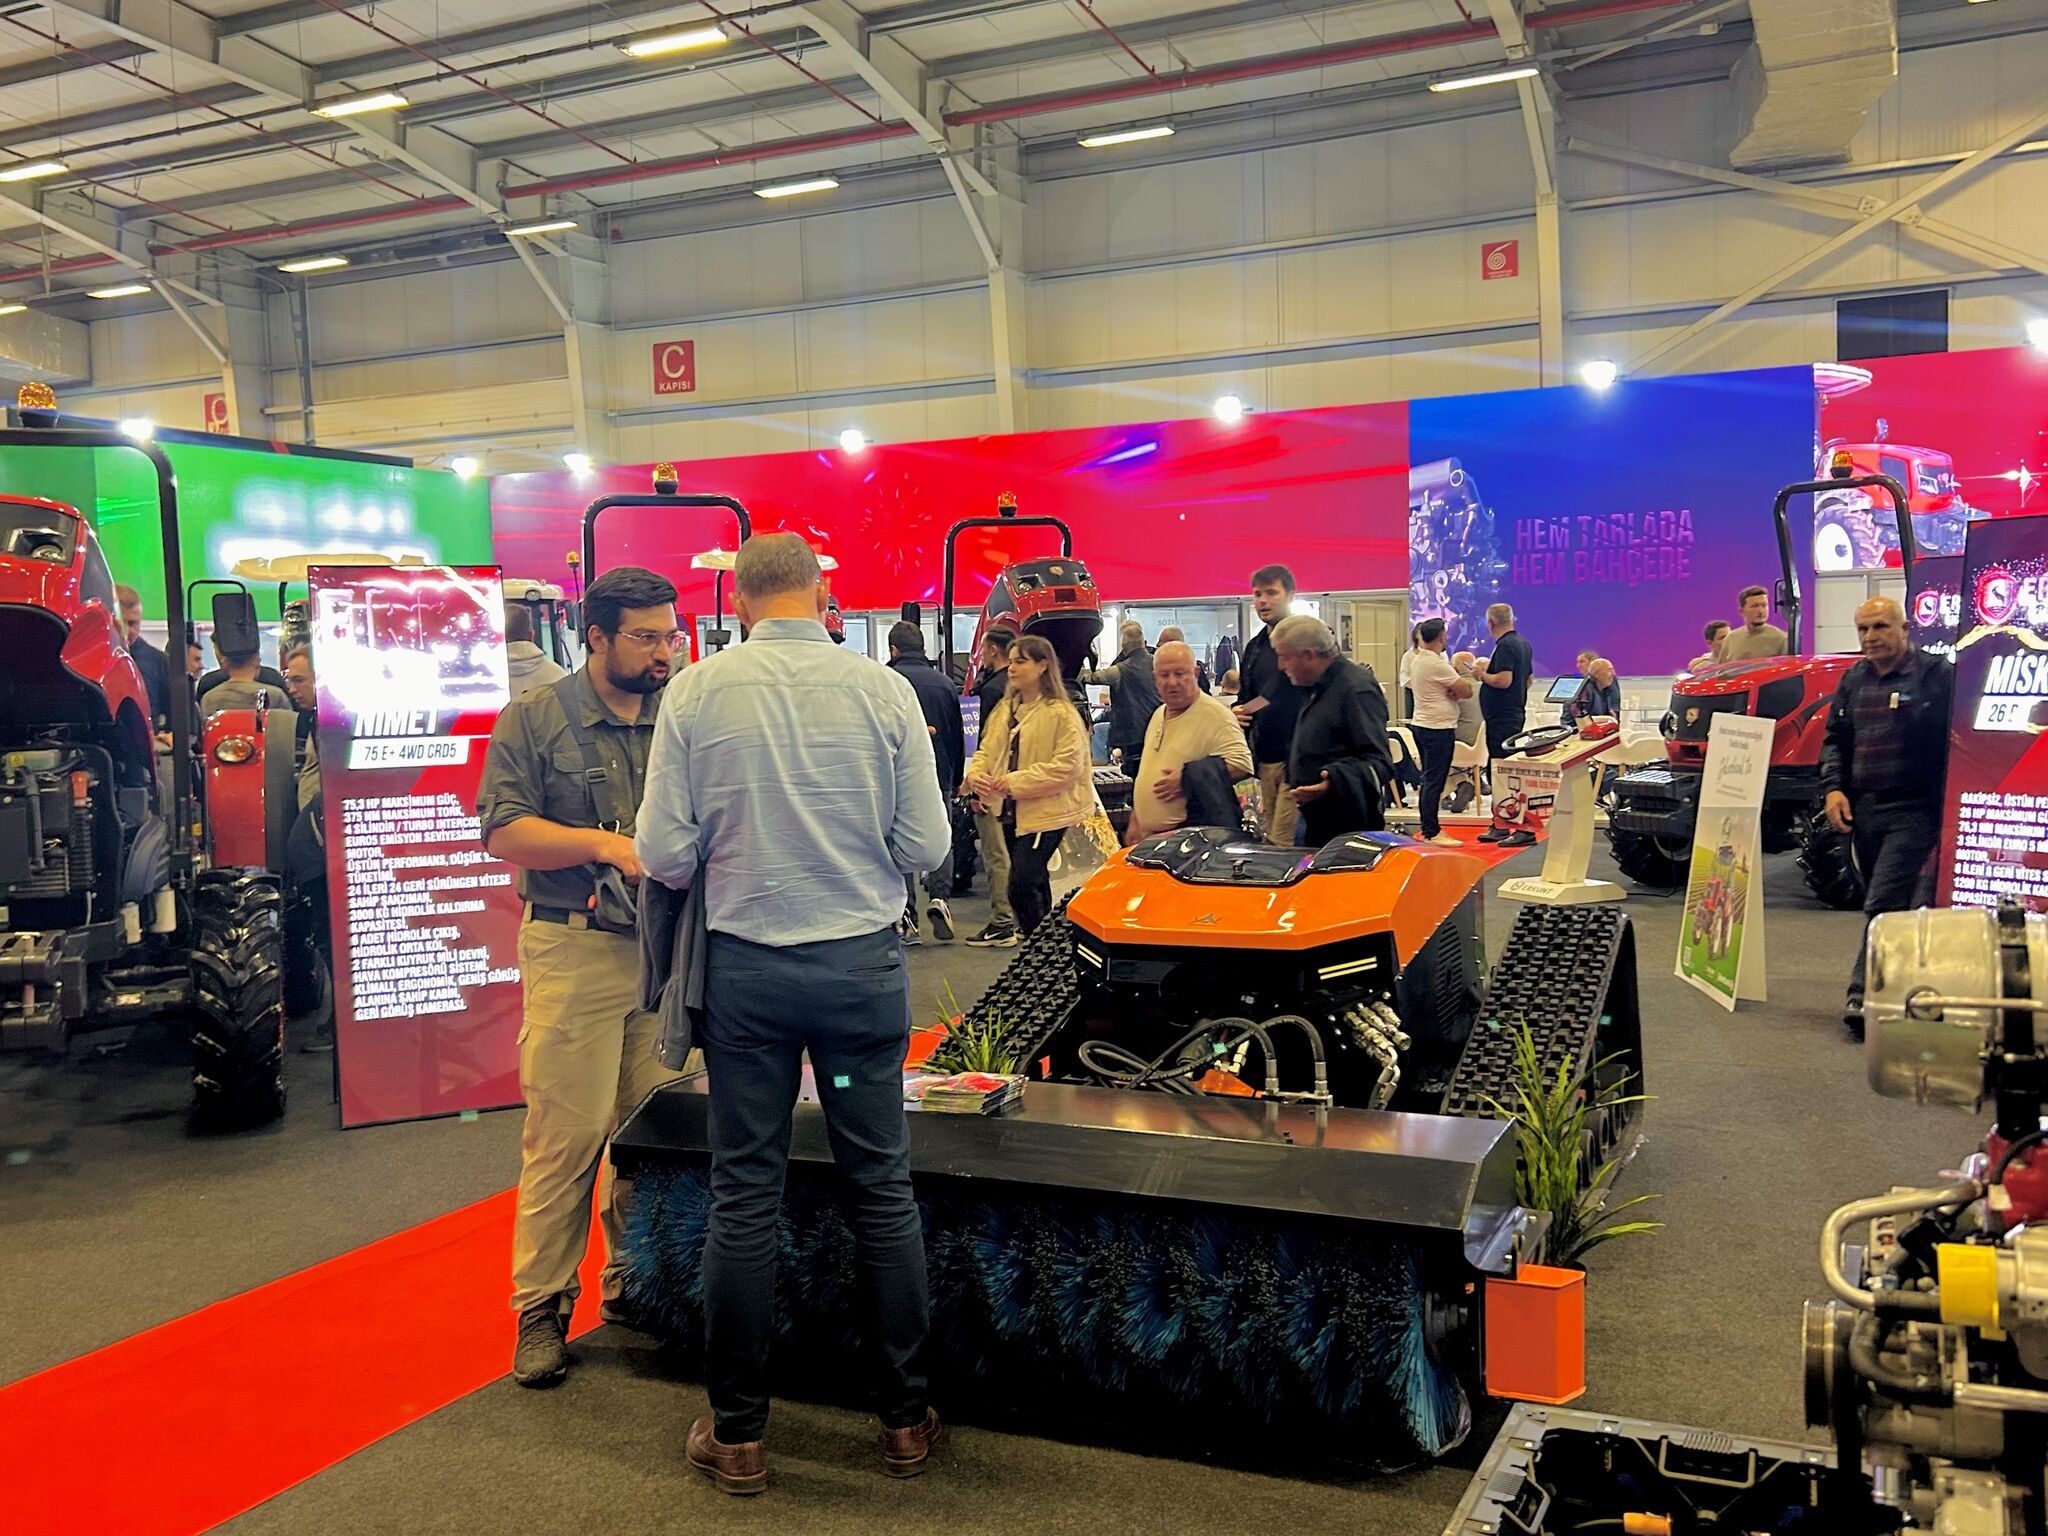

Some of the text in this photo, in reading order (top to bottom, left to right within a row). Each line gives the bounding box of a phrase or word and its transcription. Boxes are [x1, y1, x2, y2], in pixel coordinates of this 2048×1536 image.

[662, 345, 685, 379] C
[659, 381, 691, 392] KAPISI
[1516, 509, 1695, 550] HEM TARLADA
[1512, 546, 1692, 587] HEM BAHÇEDE
[1988, 703, 2008, 723] 26
[365, 743, 457, 761] 75 E+ 4WD CRD5
[366, 798, 380, 810] HP
[382, 795, 435, 809] MAKSİMUM
[437, 793, 459, 807] GÜÇ,
[382, 807, 436, 820] MAKSİMUM
[1972, 808, 1985, 819] HP
[1986, 809, 2037, 822] MAKSİMUM
[354, 820, 395, 834] SİLİNDİR
[402, 820, 434, 831] TURBO
[1994, 823, 2046, 838] MAKSİMUM
[345, 834, 378, 847] EURO5
[380, 831, 422, 845] EMİSYON
[1965, 834, 2002, 849] SİLİNDİR
[2003, 838, 2028, 851] EURO
[2028, 840, 2036, 852] 5
[346, 846, 384, 860] MOTOR,
[346, 857, 381, 872] ÜSTÜN
[382, 854, 448, 870] PERFORMANS,
[450, 850, 482, 867] DÜŞÜK
[1962, 862, 1985, 876] İLERİ
[1993, 866, 2014, 879] GERİ
[2015, 867, 2041, 882] VİTES
[363, 882, 388, 896] İLERİ
[403, 878, 425, 892] GERİ
[427, 875, 478, 891] SÜRÜNGEN
[1975, 879, 1989, 890] KG
[348, 895, 379, 909] SAHİP
[375, 906, 390, 917] KG
[391, 903, 435, 917] HİDROLİK
[437, 900, 486, 913] KALDIRMA
[360, 931, 385, 944] ADET
[387, 927, 431, 943] HİDROLİK
[351, 943, 399, 958] HİDROLİK
[400, 941, 424, 953] ORTA
[352, 959, 361, 970] 2
[362, 956, 395, 969] FARKLI
[396, 953, 436, 967] KUYRUK
[352, 969, 380, 983] HAVA
[382, 963, 447, 979] KOMPRESÖRÜ
[458, 972, 486, 987] GENİŞ
[487, 968, 521, 983] GÖRÜŞ
[354, 995, 397, 1009] ALANINA
[398, 991, 428, 1005] SAHİP
[355, 1006, 380, 1021] GERİ
[381, 1003, 414, 1018] GÖRÜŞ
